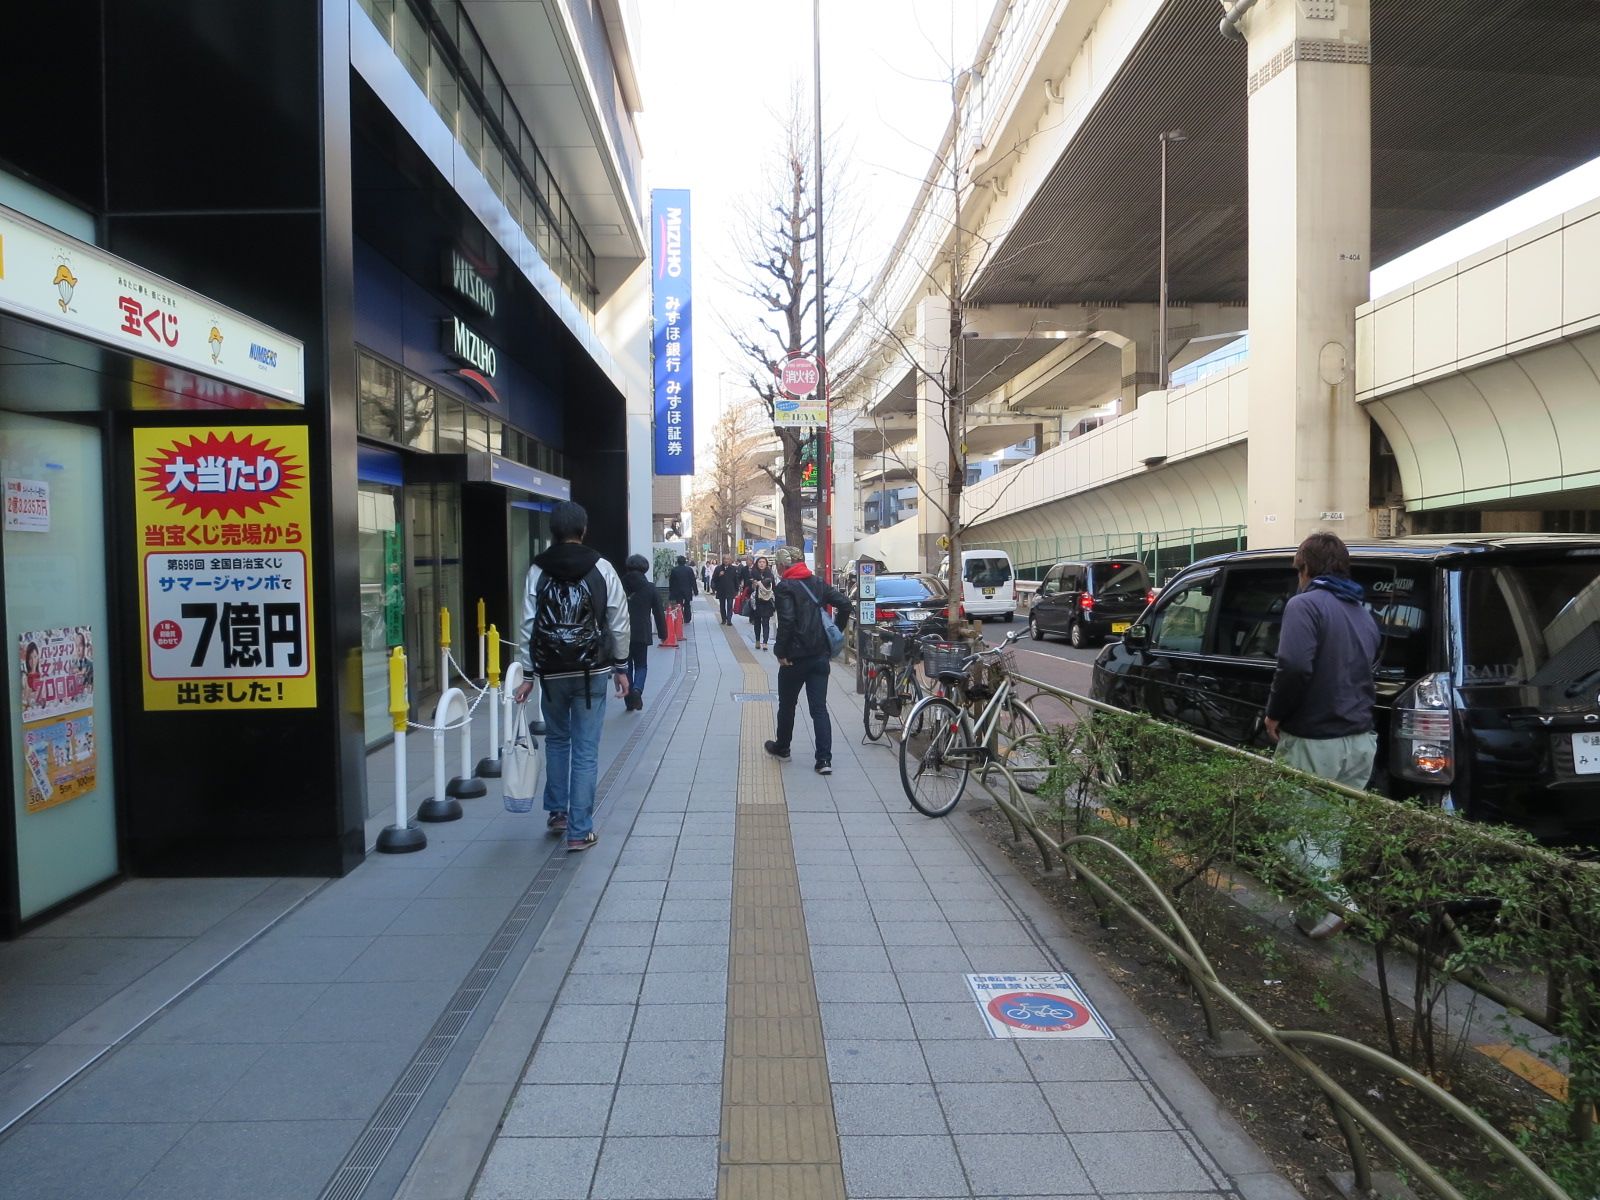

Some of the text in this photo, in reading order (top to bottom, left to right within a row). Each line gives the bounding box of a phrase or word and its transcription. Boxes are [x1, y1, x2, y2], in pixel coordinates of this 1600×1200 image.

[667, 207, 682, 278] MIZUHO
[118, 295, 179, 348] 宝くじ
[249, 342, 278, 368] NUMBERS
[453, 315, 497, 379] MIZUHO
[664, 296, 682, 456] みずほ銀行 みずほ証券
[785, 369, 816, 384] 消火栓
[165, 455, 280, 493] 大当たり
[144, 523, 302, 547] 当宝くじ売場から
[167, 557, 283, 572] 第696回 全国自治宝くじ
[158, 573, 292, 593] サマージャンボで
[181, 602, 303, 668] 7億円
[973, 975, 1065, 983] 自転車・バイク
